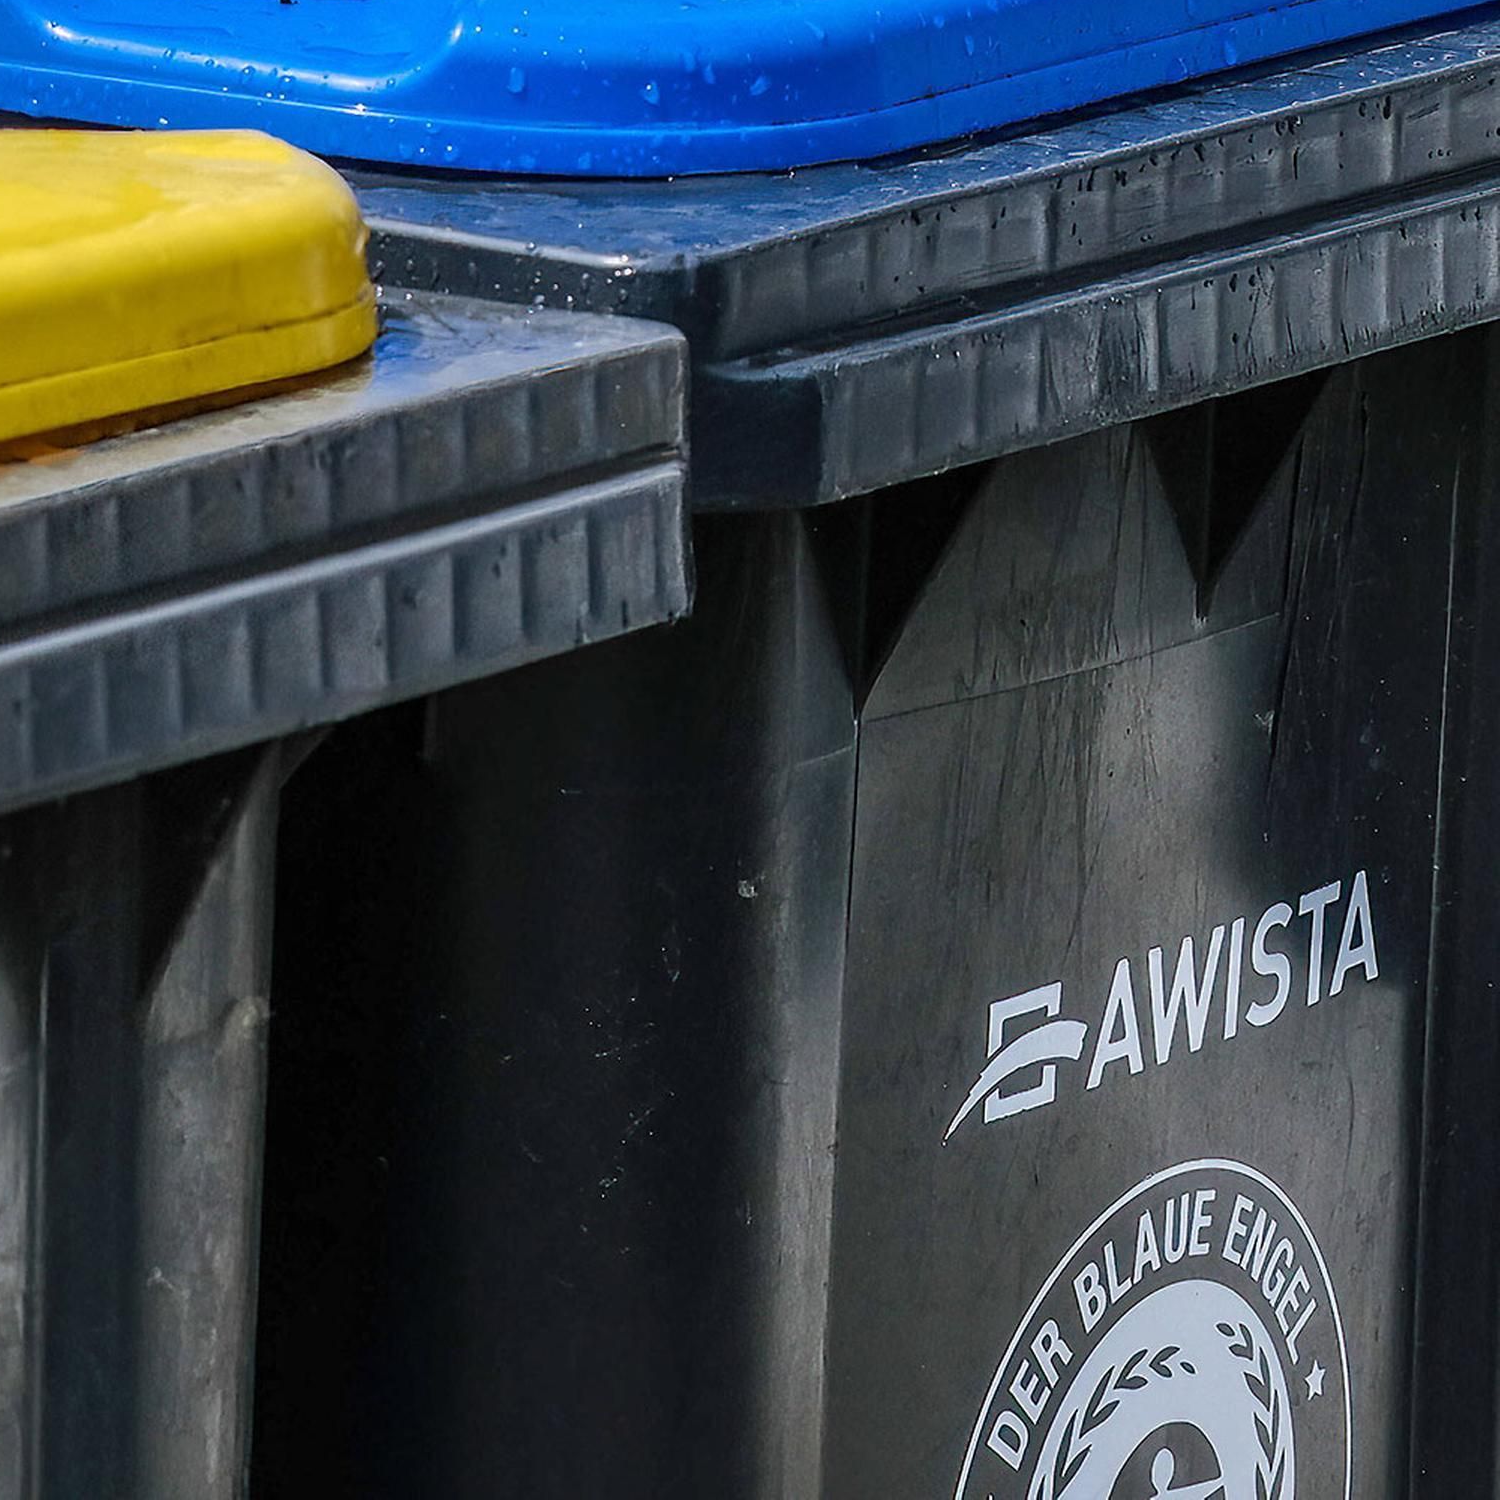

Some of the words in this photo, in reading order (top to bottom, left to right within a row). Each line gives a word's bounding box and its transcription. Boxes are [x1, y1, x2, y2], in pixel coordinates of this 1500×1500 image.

[1085, 870, 1379, 1090] AWISTA
[987, 1318, 1074, 1471] DER
[1072, 1189, 1217, 1334] BLAUE
[1220, 1194, 1319, 1364] ENGEL
